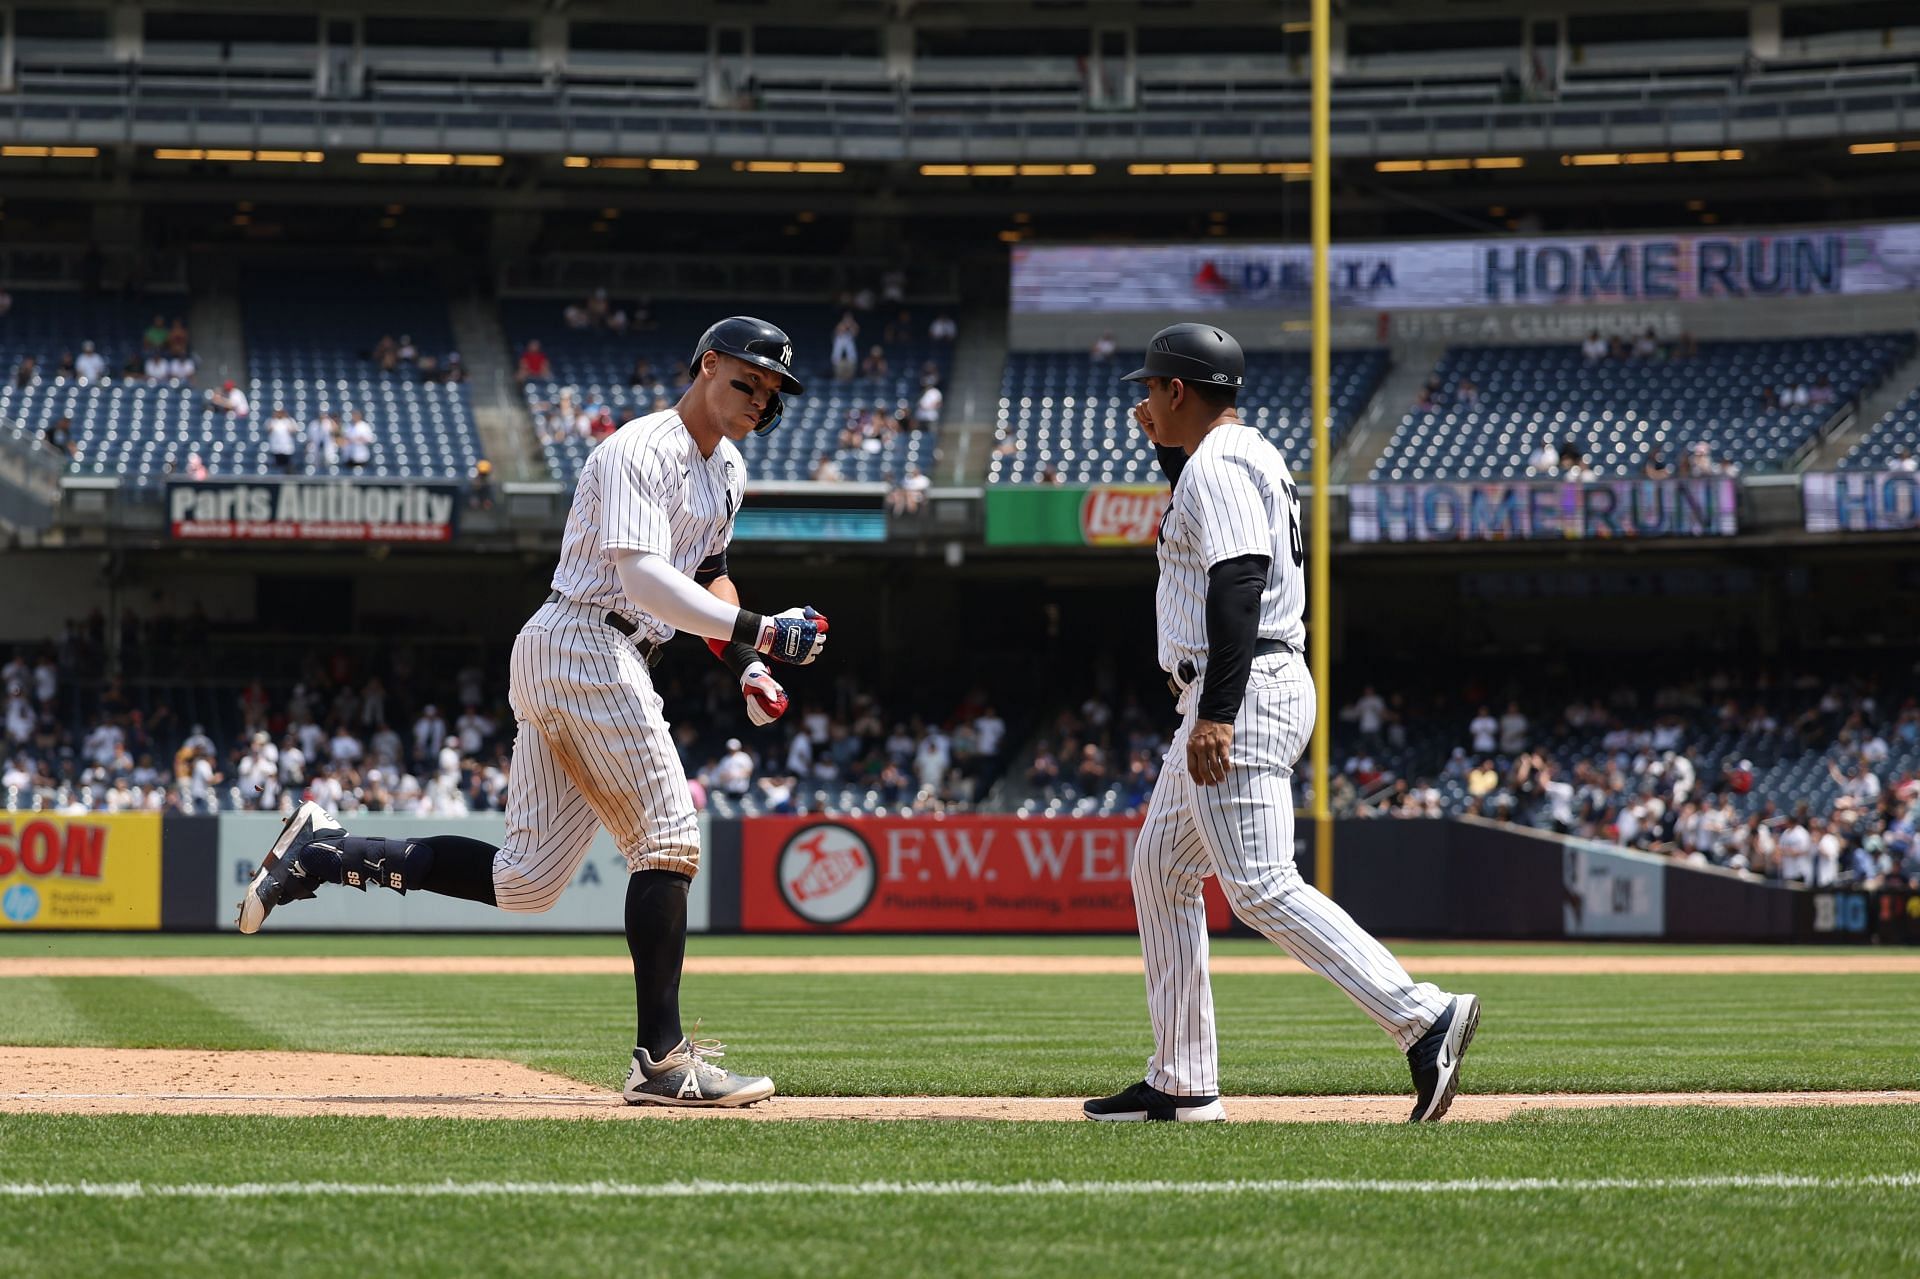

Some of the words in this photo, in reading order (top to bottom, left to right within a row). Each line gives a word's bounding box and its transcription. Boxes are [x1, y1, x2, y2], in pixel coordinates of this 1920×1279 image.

[1244, 261, 1396, 290] DETA
[1485, 242, 1678, 300] HOME
[1697, 234, 1843, 296] RUN
[171, 486, 271, 521] Parts
[276, 481, 452, 524] Authority
[1376, 484, 1562, 540] HOME
[1583, 481, 1717, 537] RUN
[885, 828, 997, 881] F.W.
